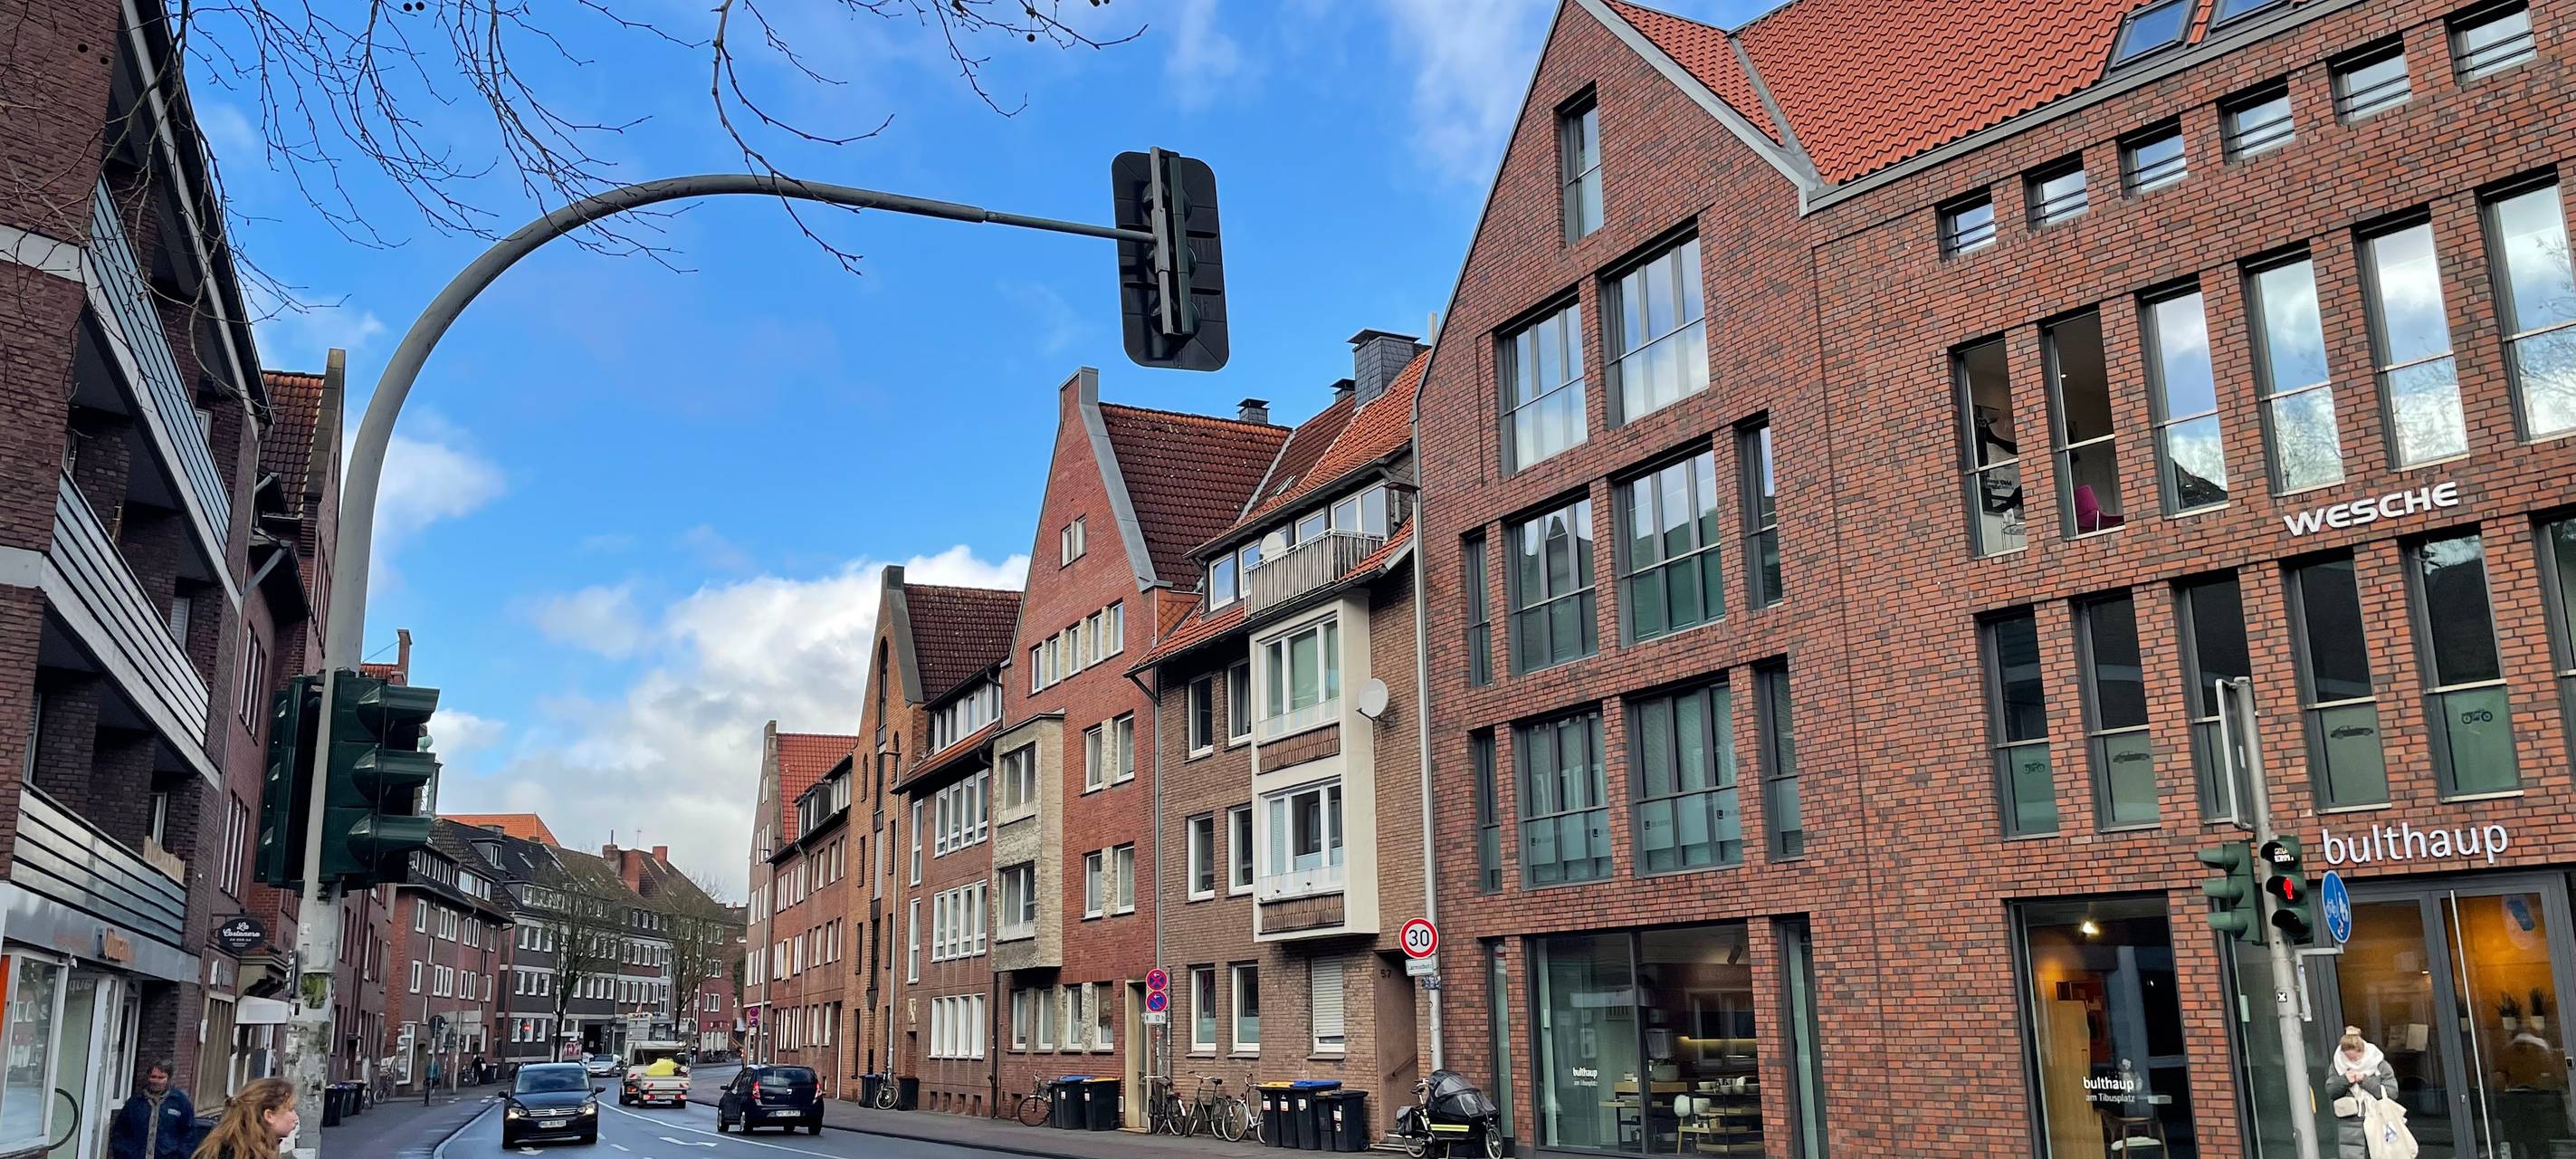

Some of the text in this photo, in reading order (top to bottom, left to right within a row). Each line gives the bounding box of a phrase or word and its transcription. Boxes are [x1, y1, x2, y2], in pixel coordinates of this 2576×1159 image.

[2283, 481, 2458, 537] WESCHE
[2322, 822, 2508, 864] bulthaup
[236, 922, 250, 931] La
[1408, 929, 1429, 947] 30
[1380, 969, 1392, 979] 57
[2083, 1076, 2134, 1093] bulthaup
[2098, 1092, 2135, 1104] Tibusplatz
